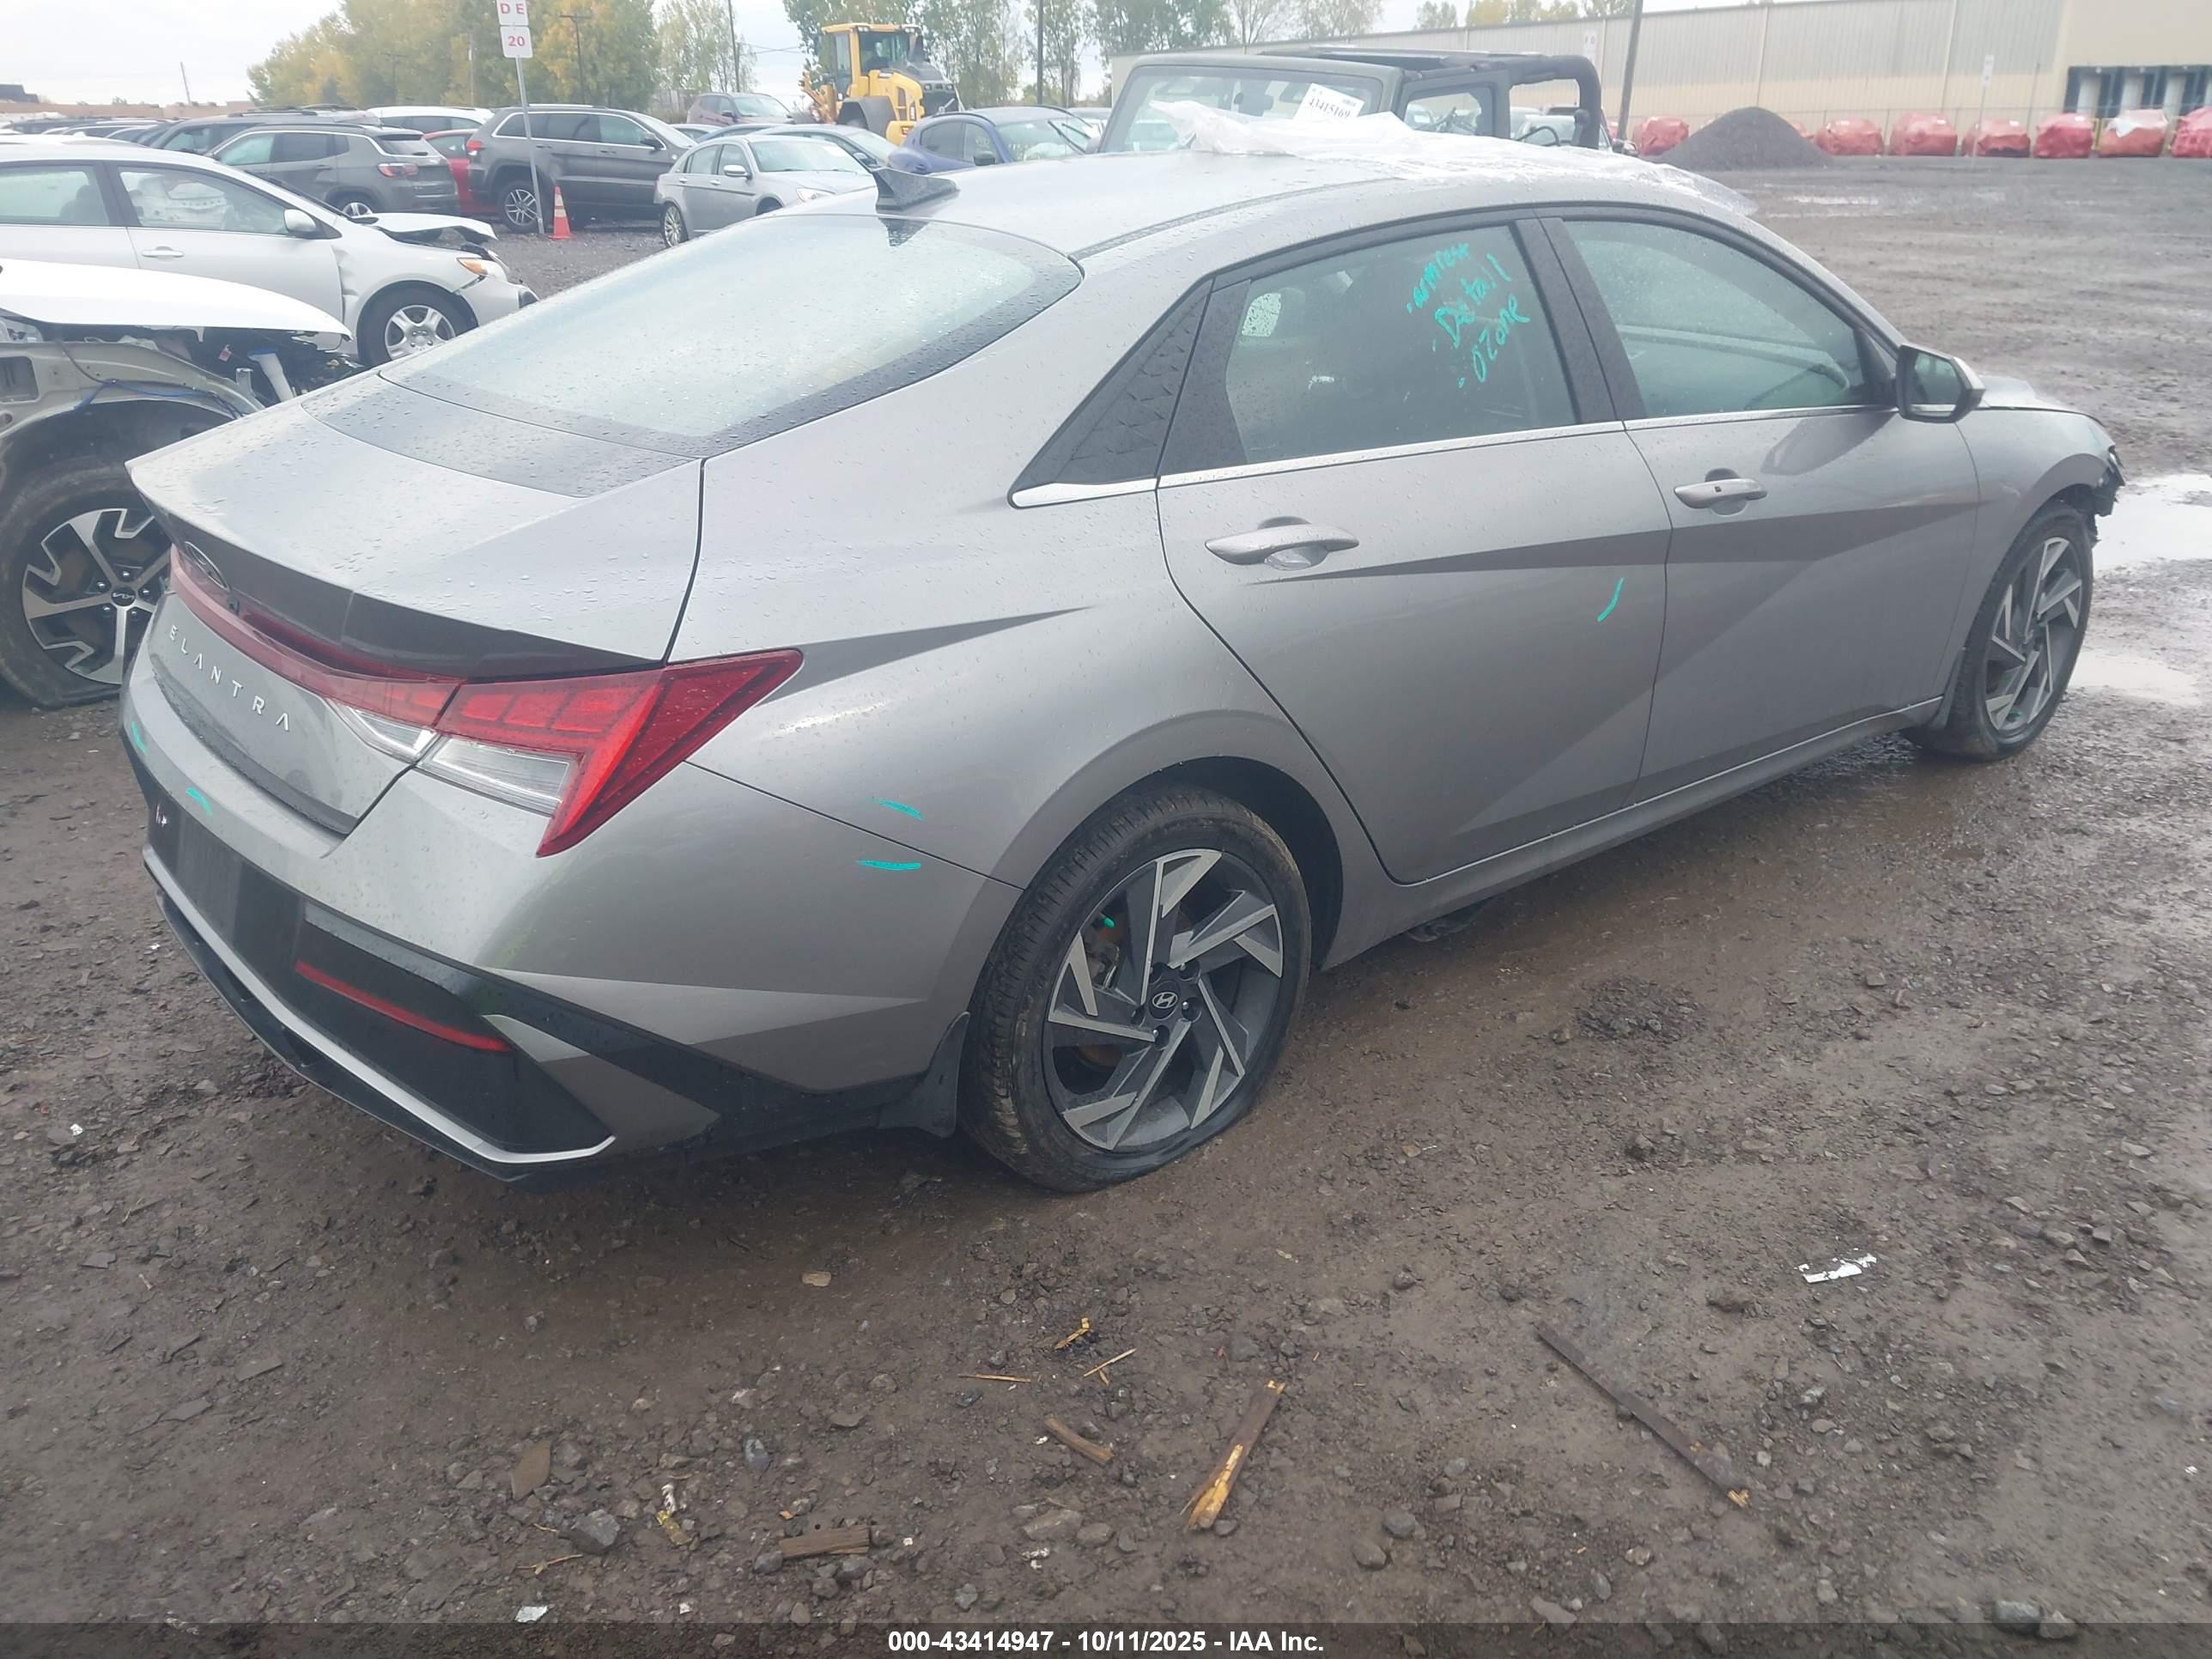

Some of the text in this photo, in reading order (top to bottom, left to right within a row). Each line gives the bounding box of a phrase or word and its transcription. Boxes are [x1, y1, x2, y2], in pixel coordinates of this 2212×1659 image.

[501, 3, 524, 14] D E
[508, 36, 525, 46] 20
[169, 624, 290, 732] ELANTRA
